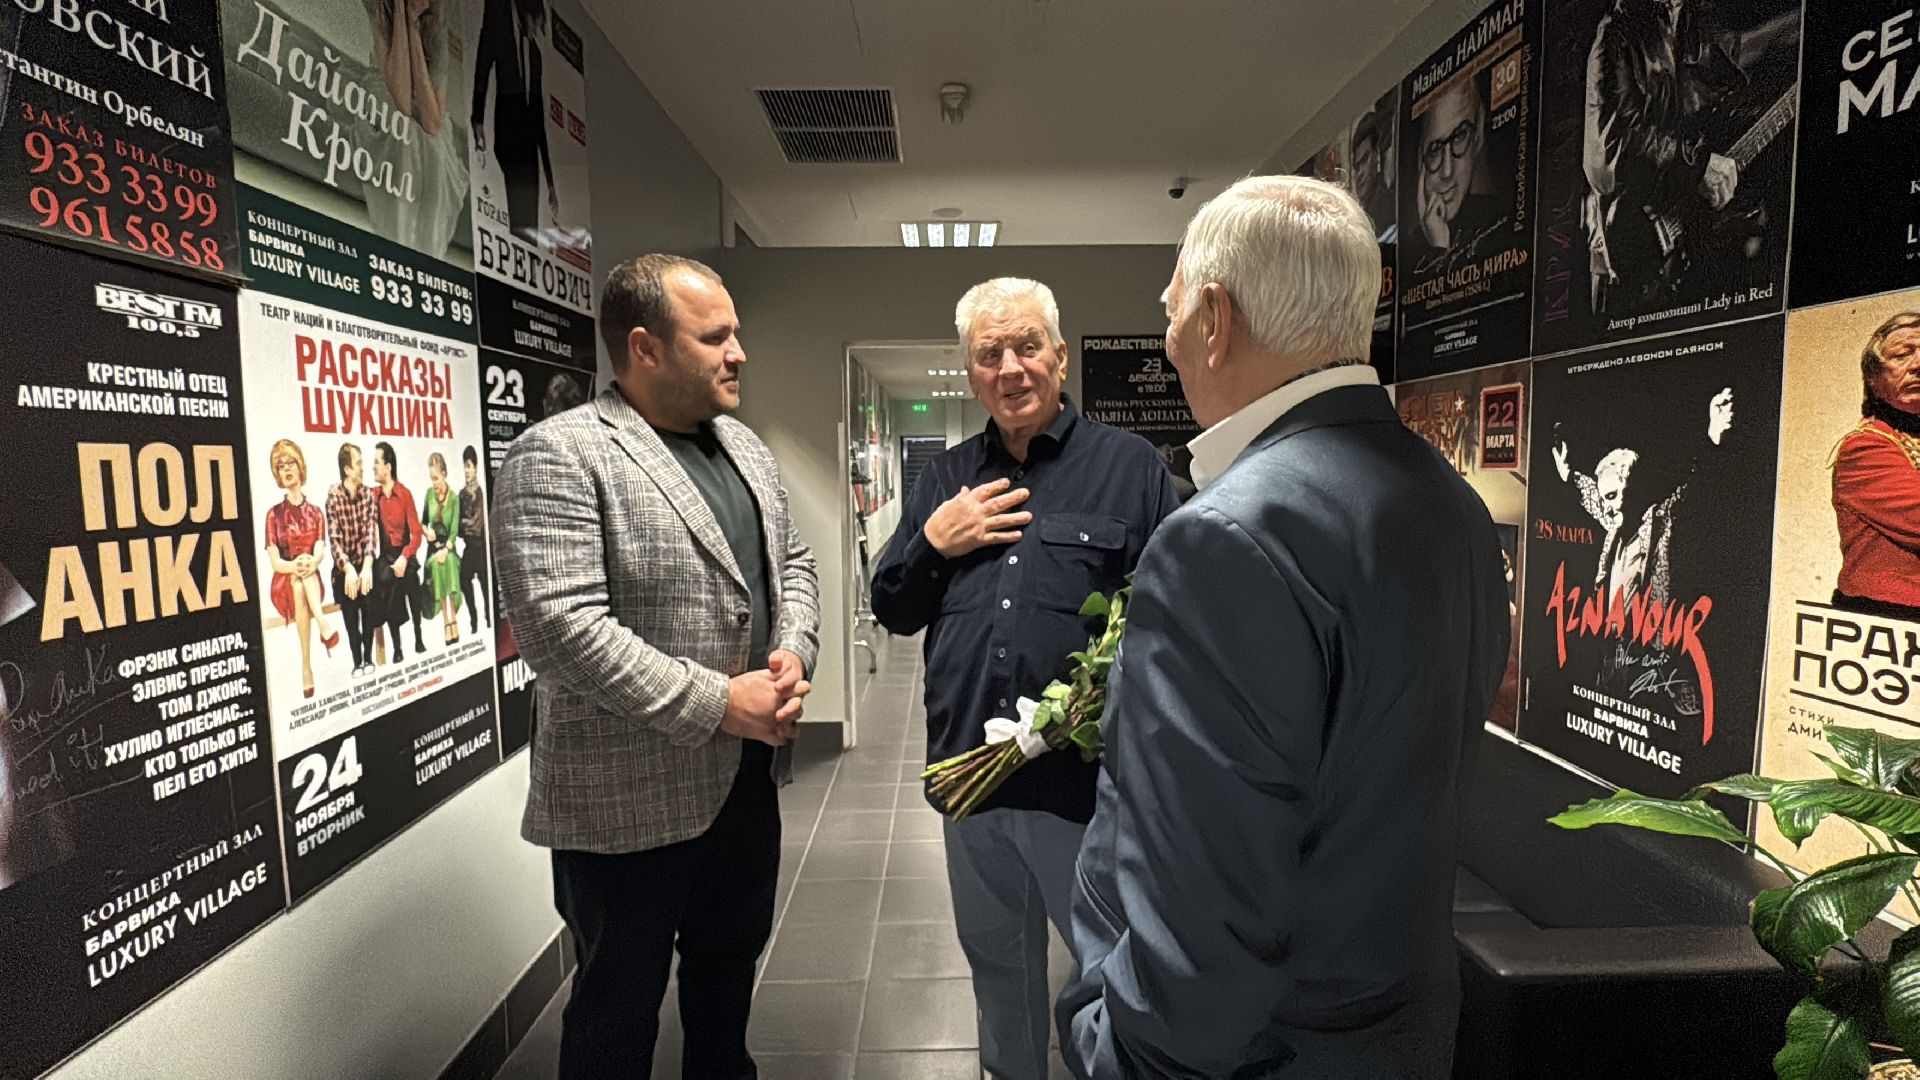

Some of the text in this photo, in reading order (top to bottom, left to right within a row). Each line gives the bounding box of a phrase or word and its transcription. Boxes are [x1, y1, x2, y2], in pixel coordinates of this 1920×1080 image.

[1412, 55, 1453, 100] Майкл
[1456, 0, 1524, 66] НАЙМАН
[1841, 8, 1920, 72] СЕ
[237, 0, 411, 146] Дайана
[1495, 60, 1516, 90] 30
[103, 90, 204, 148] Орбелян
[21, 101, 217, 188] ЗАКАЗ БИЛЕТОВ
[281, 91, 415, 203] Кролл
[24, 131, 217, 227] 933 33 99
[29, 186, 224, 270] 961 58 58
[248, 210, 358, 258] КОНЦЕРТНЫЙ ЗАЛ
[248, 228, 305, 258] БАРВИХА
[249, 247, 360, 294] LUXURY VILLAGE
[369, 254, 472, 301] ЗАКАЗ БИЛЕТОВ:
[477, 226, 592, 310] БРЕГОВИЧ
[1447, 264, 1480, 288] ЧАСТЬ
[1484, 248, 1528, 278] МИРА»
[95, 285, 223, 327] BEST FM
[371, 275, 472, 325] 933 33 99
[1607, 282, 1773, 331] Автор композиции Lady in Red
[127, 315, 200, 338] 100.5
[260, 303, 290, 321] ТЕАТР
[294, 310, 324, 328] НАЦИЙ
[327, 318, 333, 331] И
[335, 320, 418, 349] БЛАГОТВОРИТЕЛЬНЫЙ
[1083, 338, 1166, 350] РОЖДЕСТВЕН
[295, 334, 452, 400] РАССКАЗЫ
[1142, 358, 1162, 373] 23
[1624, 349, 1673, 364] ЛЕВОНОМ
[1676, 342, 1724, 356] САЯНОМ
[17, 384, 229, 418] АМЕРИКАНСКОЙ ПЕСНИ
[87, 361, 229, 398] КРЕСТНЫЙ ОТЕЦ
[486, 365, 525, 408] 23
[301, 386, 454, 439] ШУКШИНА
[1487, 401, 1514, 428] 22
[1486, 433, 1514, 448] МАРТА
[77, 442, 239, 531] ПОЛ
[1535, 518, 1593, 544] 28 МАРТА
[41, 530, 249, 642] АНКА
[118, 632, 248, 678] ФРЭНК СИНАТРА,
[1546, 560, 1714, 746] AZNAVOUR
[132, 655, 250, 703] ЭЛВИС ПРЕСЛИ,
[158, 678, 252, 721] ТОМ ДЖОНС,
[1793, 649, 1920, 706] ПОЭ
[413, 708, 475, 751] КОНЦЕРТНЫЙ
[1572, 685, 1677, 731] КОНЦЕРТНЫЙ ЗАЛ
[1594, 707, 1650, 739] БАРВИХА
[1789, 705, 1835, 725] СТИХИ
[104, 703, 254, 766] ХУЛИО ИГЛЕСИАС...
[145, 721, 257, 778] КТО ТОЛЬКО НЕ
[414, 736, 454, 766] БАРВИХА
[416, 728, 492, 786] LUXURY VILLAGE
[1566, 711, 1682, 774] LUXURY VILLAGE
[153, 742, 258, 801] ПЕЛ ЕГО ХИТЫ
[291, 734, 363, 815] 24
[294, 790, 355, 837] НОЯБРЯ
[297, 804, 366, 858] ВТОРНИК
[81, 824, 262, 931] КОНЦЕРТНЫЙ ЗАЛ
[85, 891, 182, 956] БАРВИХА
[88, 861, 267, 988] LUXURY VILLAGE
